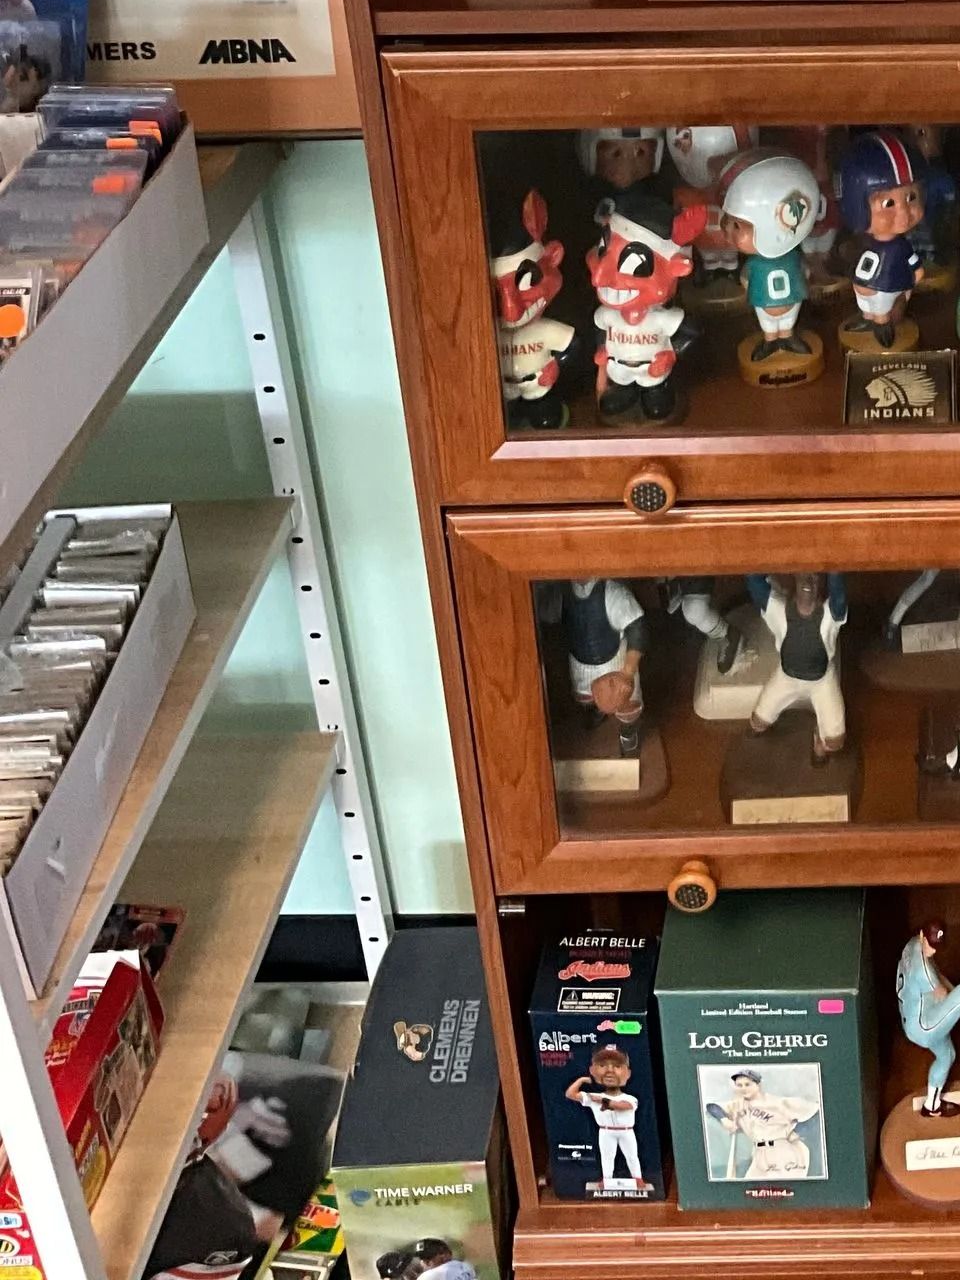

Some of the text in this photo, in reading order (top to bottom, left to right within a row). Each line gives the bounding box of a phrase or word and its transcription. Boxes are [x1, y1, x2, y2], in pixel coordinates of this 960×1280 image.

[199, 38, 297, 65] MBNA
[608, 326, 659, 345] INDIANS
[872, 363, 928, 373] CLEVELAND
[863, 406, 935, 419] INDIANS
[559, 936, 647, 949] ALBERT BELLE
[429, 999, 460, 1083] CLEMENS
[450, 999, 481, 1083] DRENNEN
[539, 1030, 598, 1044] Albert
[687, 1030, 828, 1049] LOU GEHRIG
[538, 1041, 571, 1052] Belle
[374, 1183, 474, 1199] TIME WARNER
[592, 1190, 649, 1198] ALBERT BELLE
